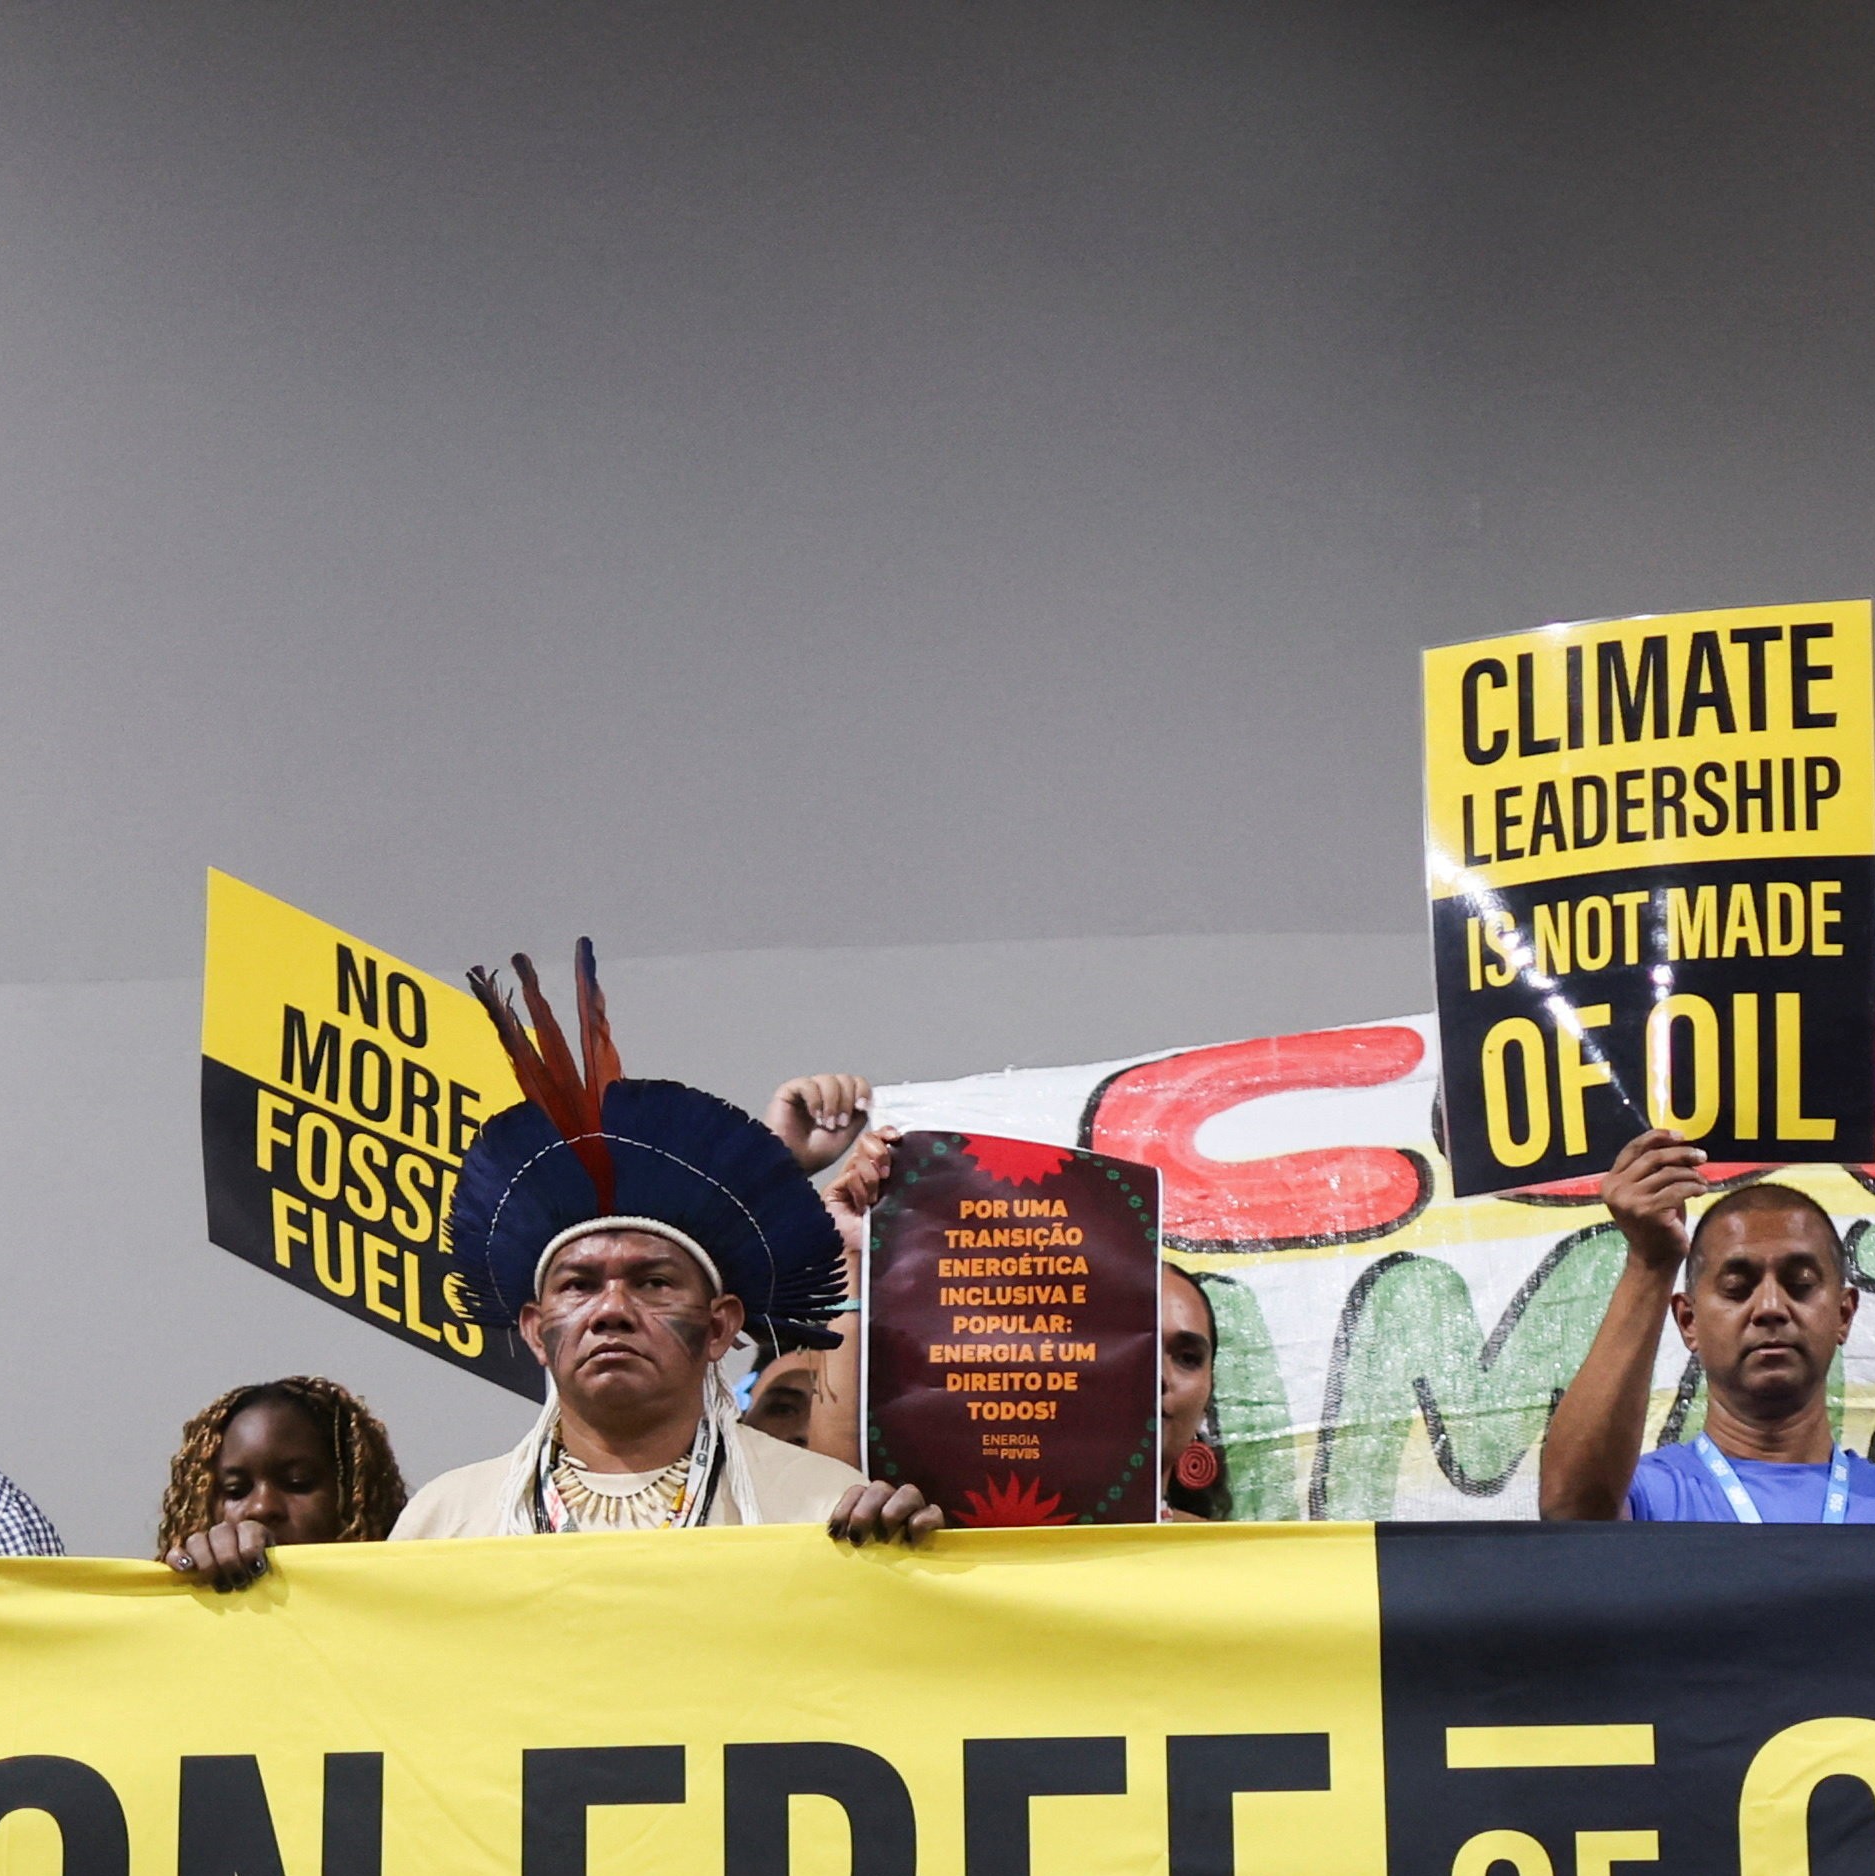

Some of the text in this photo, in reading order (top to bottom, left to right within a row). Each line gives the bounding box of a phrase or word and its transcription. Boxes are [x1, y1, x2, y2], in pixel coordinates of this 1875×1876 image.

[1460, 622, 1838, 766] CLIMATE
[1461, 755, 1842, 868] LEADERSHIP
[1468, 881, 1844, 991] IS NOT MADE
[336, 943, 428, 1049] NO
[281, 1004, 482, 1154] MORE
[1481, 992, 1836, 1168] OF OIL
[959, 1199, 1067, 1219] POR UMA
[945, 1222, 1083, 1251] TRANSIÇÃO
[938, 1252, 1088, 1278] ENERGÉTICA
[940, 1285, 1086, 1306] INCLUSIVA E
[953, 1314, 1072, 1334] POPULAR:
[929, 1339, 1096, 1363] ENERGIA É UM
[947, 1372, 1078, 1392] DIREITO DE
[967, 1400, 1057, 1421] TODOS!
[982, 1434, 1040, 1446] ENERGIA
